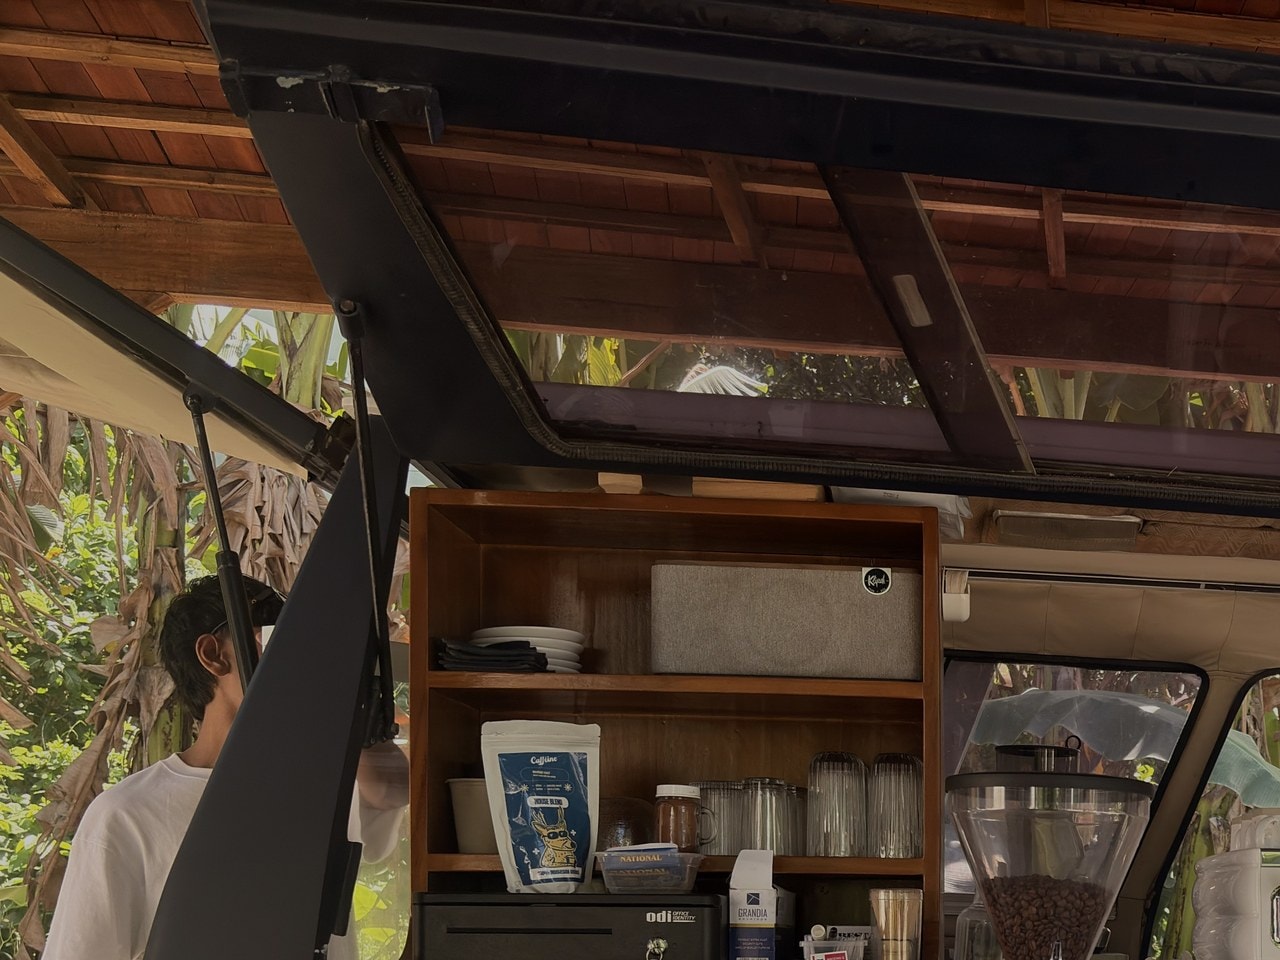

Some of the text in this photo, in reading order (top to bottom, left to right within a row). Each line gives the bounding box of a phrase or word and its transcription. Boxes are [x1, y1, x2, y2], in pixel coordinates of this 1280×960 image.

[620, 854, 663, 863] NATIONAL
[645, 910, 671, 923] odi
[738, 908, 768, 918] GRANDIA
